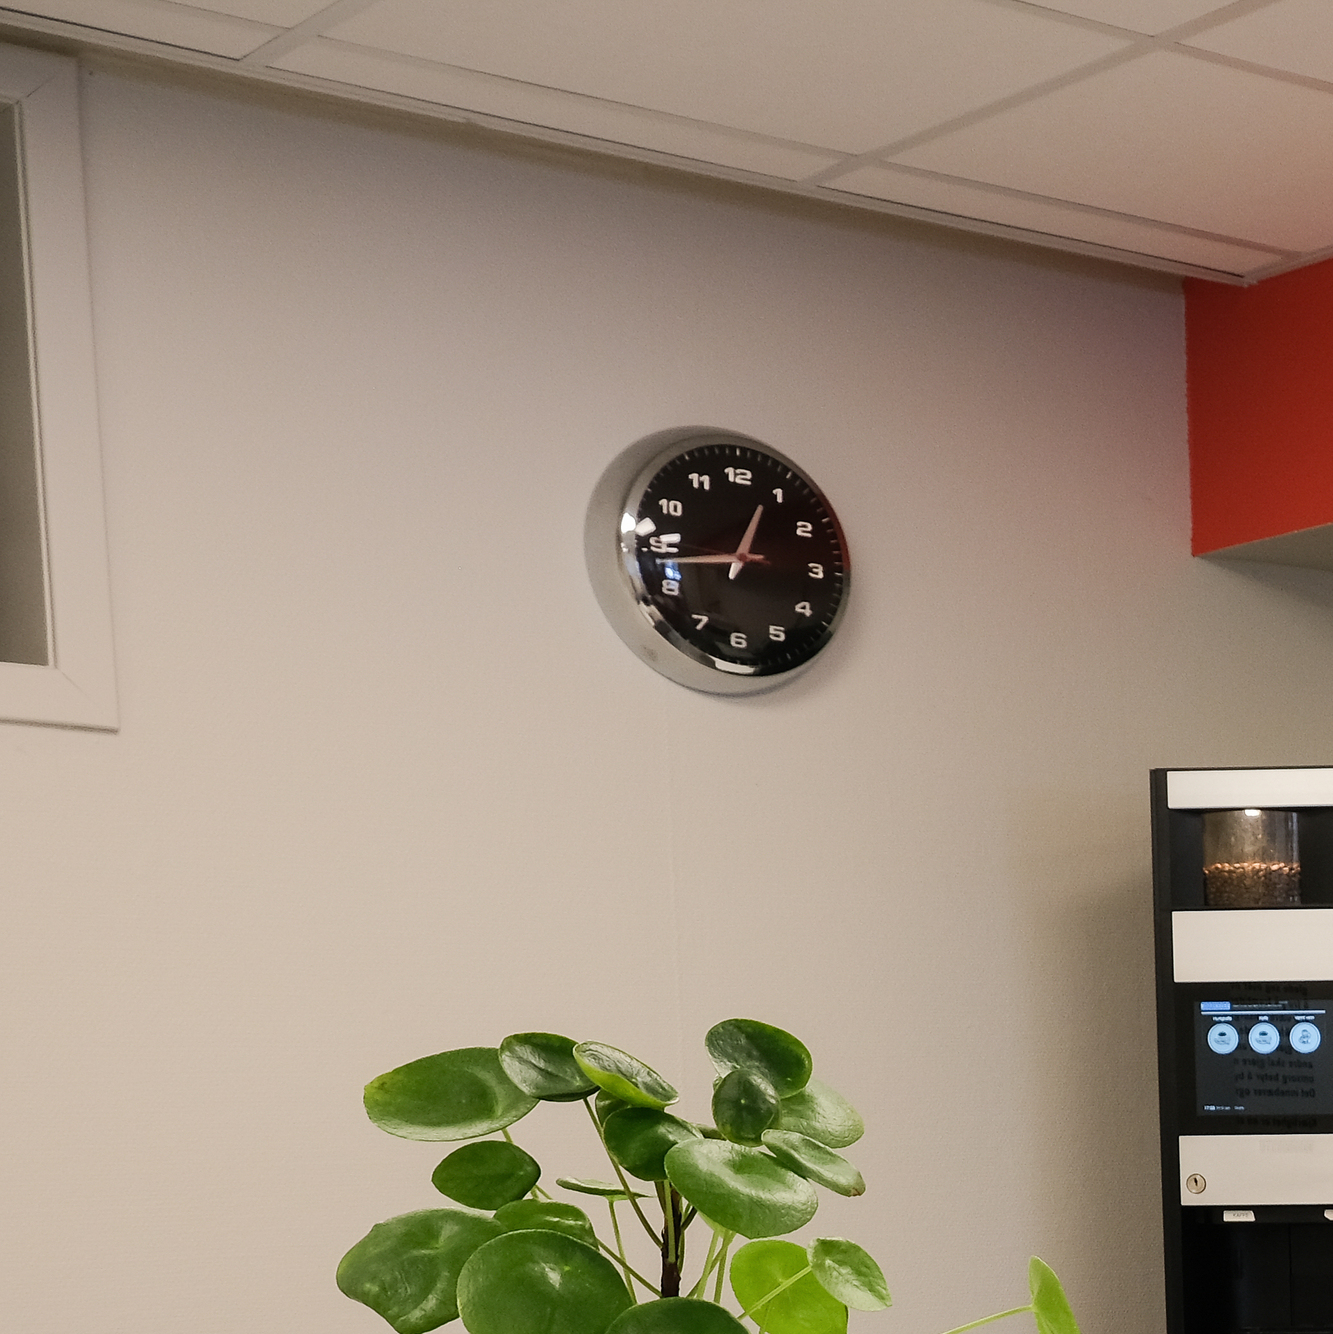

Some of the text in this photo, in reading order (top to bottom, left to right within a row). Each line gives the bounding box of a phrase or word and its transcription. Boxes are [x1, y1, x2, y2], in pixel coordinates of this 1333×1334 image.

[688, 472, 711, 491] 11
[724, 466, 753, 486] 12
[772, 487, 783, 504] 1
[658, 498, 683, 517] 10
[795, 520, 813, 538] 2
[807, 562, 825, 580] 3
[661, 579, 680, 596] 8
[794, 601, 813, 618] 4
[691, 614, 710, 631] 7
[729, 632, 748, 650] 6
[768, 625, 786, 642] 5
